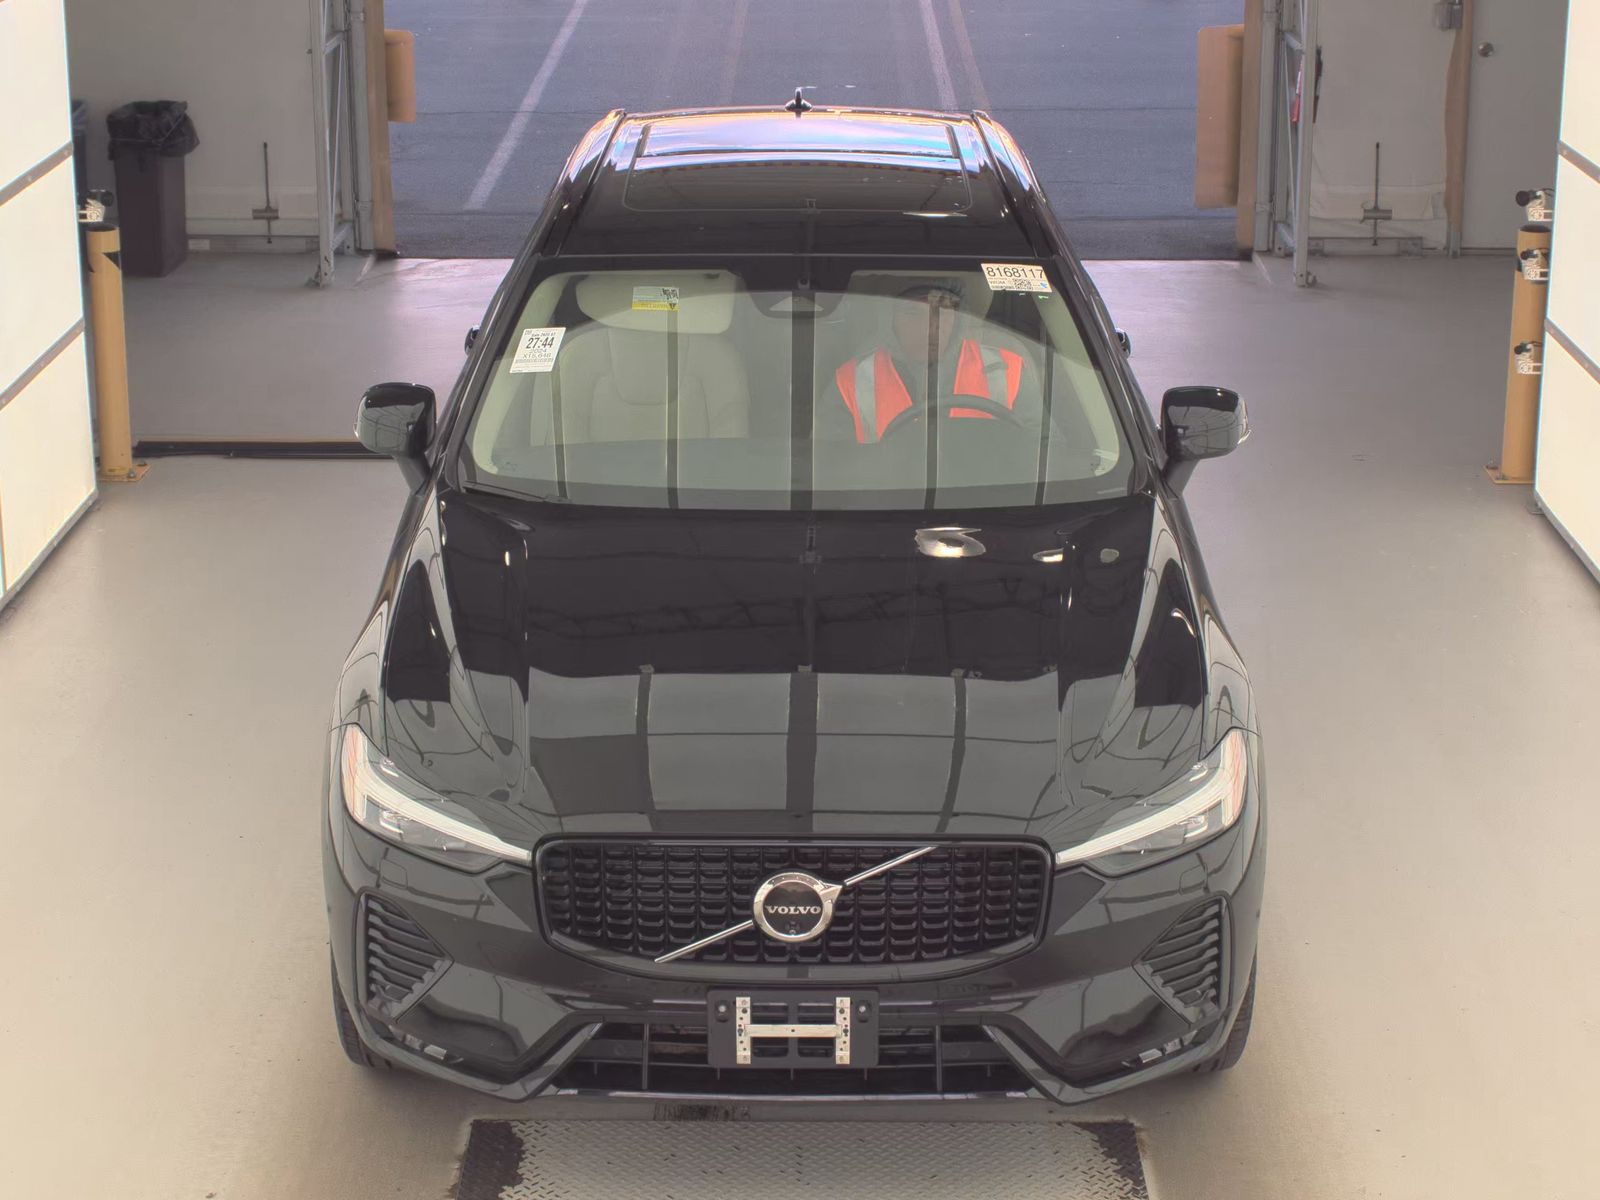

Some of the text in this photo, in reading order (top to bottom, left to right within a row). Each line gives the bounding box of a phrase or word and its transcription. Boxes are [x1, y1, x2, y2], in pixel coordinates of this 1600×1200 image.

[986, 267, 1043, 279] 8168117
[526, 337, 555, 349] 27:44
[765, 905, 822, 915] VOLVO
